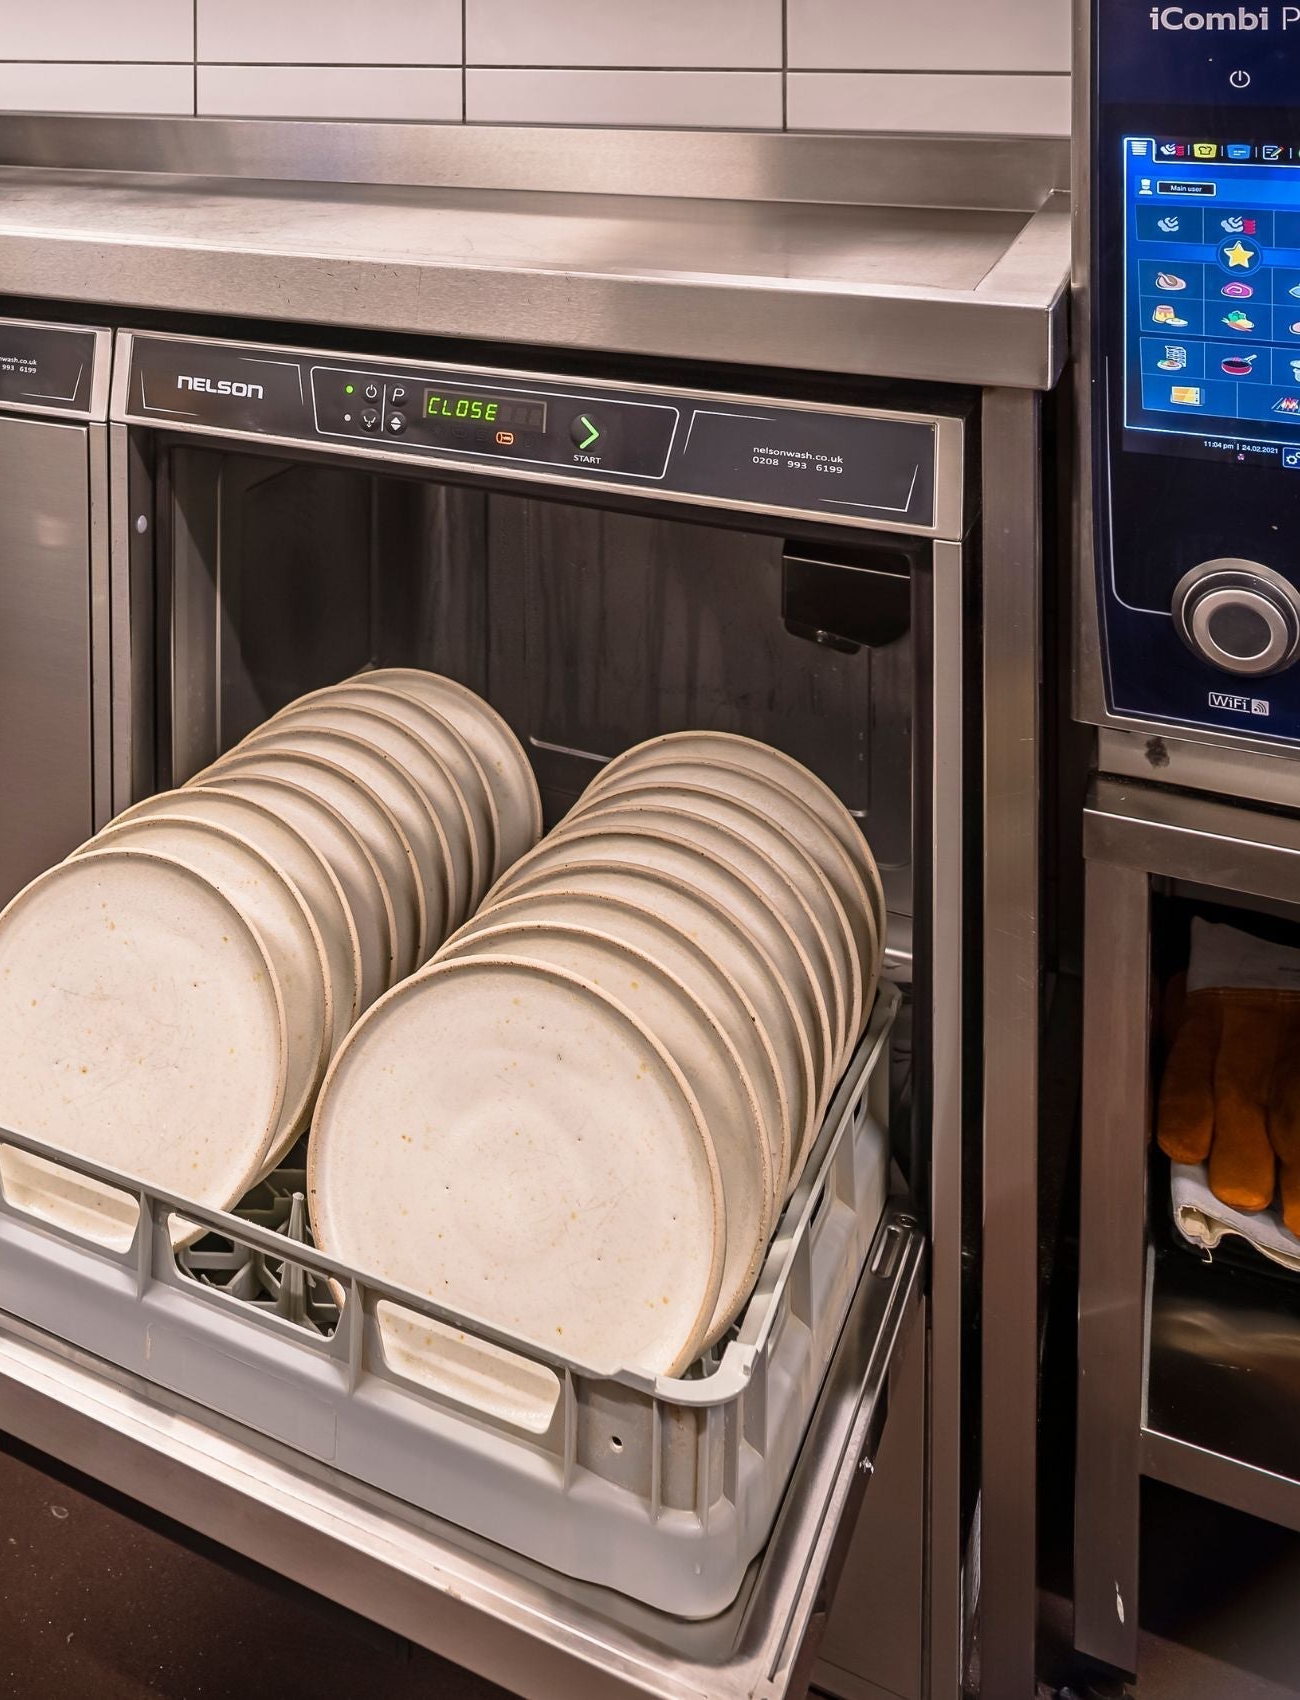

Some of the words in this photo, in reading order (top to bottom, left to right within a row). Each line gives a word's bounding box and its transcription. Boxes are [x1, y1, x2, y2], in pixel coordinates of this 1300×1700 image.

[1150, 7, 1269, 31] iCombi
[1282, 7, 1300, 31] P
[1170, 184, 1186, 193] Main
[19, 366, 36, 374] 6199
[177, 375, 264, 400] NELSON
[392, 387, 405, 402] P
[427, 397, 498, 421] CLOSE
[753, 447, 844, 464] nelsonwash.co.uk
[1203, 441, 1221, 449] 11:04
[1241, 445, 1278, 454] 24.02.2021
[573, 454, 602, 464] START
[752, 456, 779, 466] 0208
[787, 460, 807, 469] 993
[815, 464, 843, 474] 6199
[1212, 694, 1247, 710] WiFi
